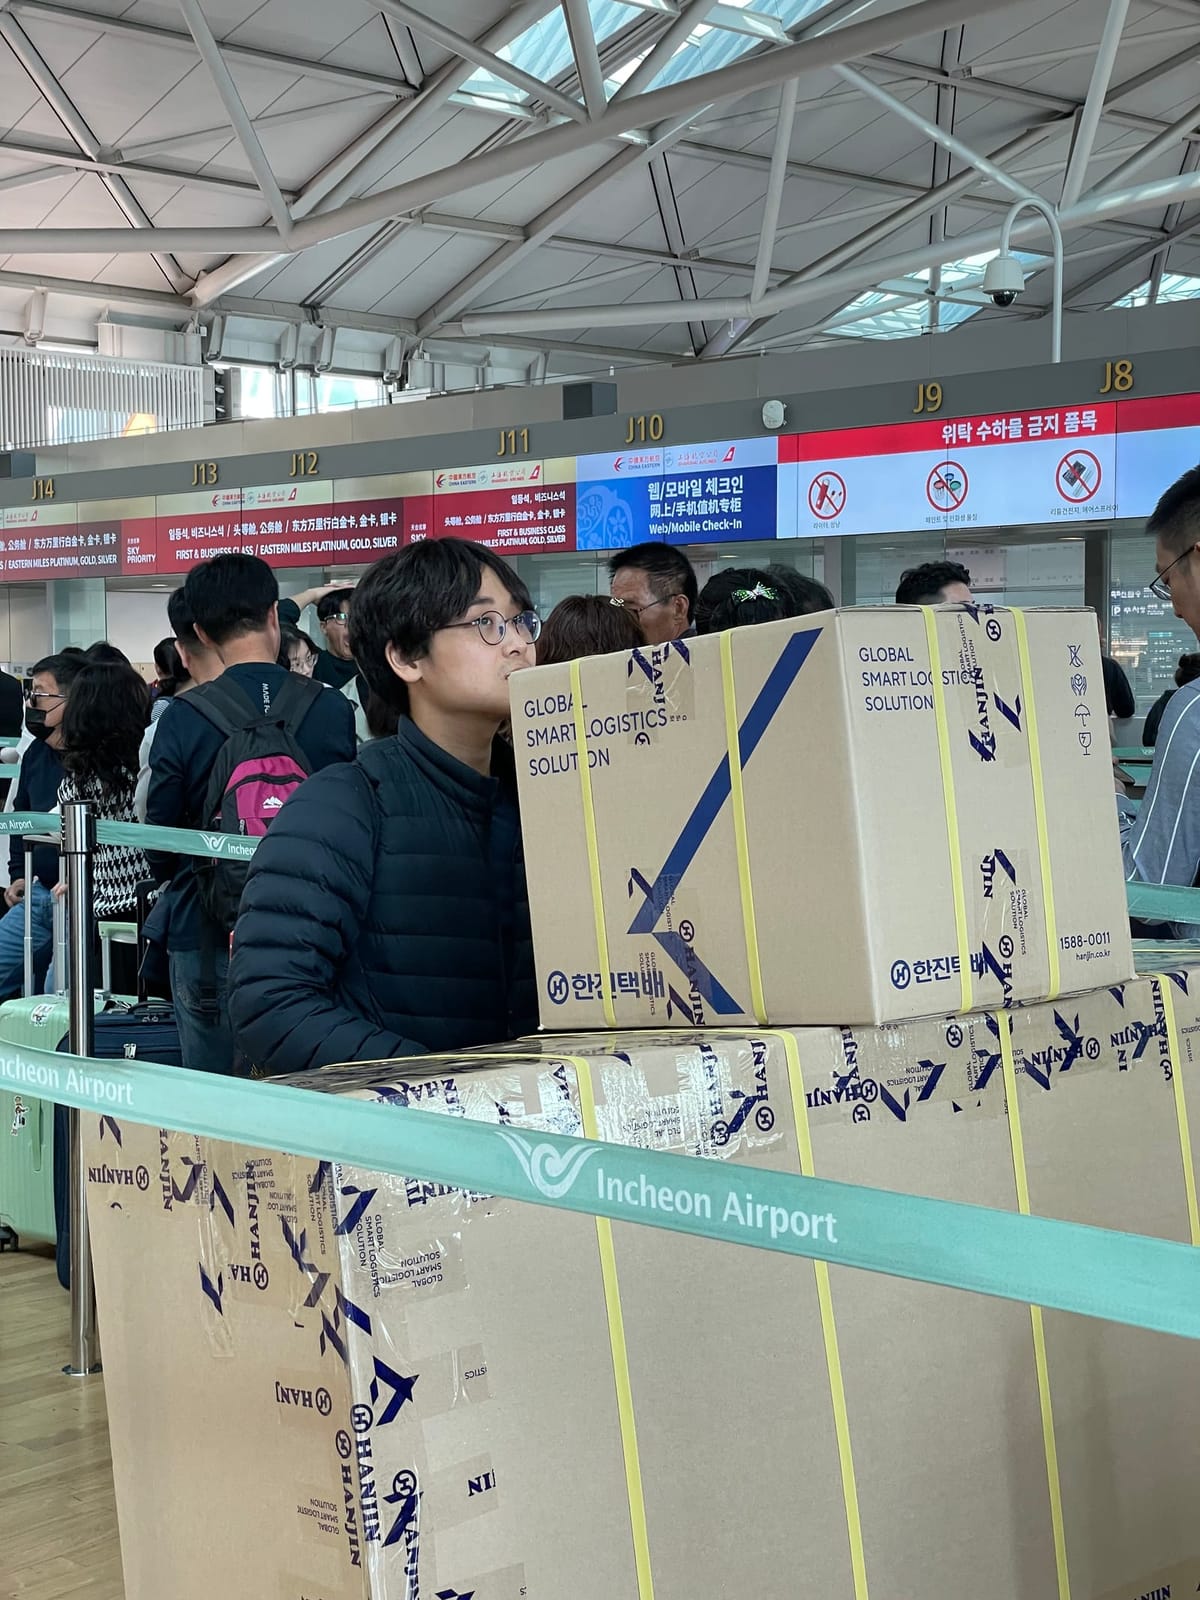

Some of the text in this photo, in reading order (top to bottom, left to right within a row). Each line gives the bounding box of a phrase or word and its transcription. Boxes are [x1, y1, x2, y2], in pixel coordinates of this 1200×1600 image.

[1099, 359, 1133, 393] J8
[913, 382, 943, 414] J9
[625, 414, 664, 443] J10
[941, 409, 1098, 445] 위탁 수하물 금지 품목
[497, 428, 529, 456] J11
[192, 463, 218, 485] J13
[289, 452, 318, 476] J12
[32, 478, 55, 500] J14
[648, 474, 744, 501] 웹/모바일 체크인
[650, 497, 742, 519] 网上/手机值机专柜
[191, 524, 224, 539] 비즈니스석
[497, 528, 513, 537] FIRST
[519, 526, 548, 536] BUSINESS
[548, 525, 566, 534] CLASS
[649, 518, 743, 535] Web/Mobile Check-In
[175, 549, 194, 560] FIRST
[194, 549, 200, 559] &
[260, 543, 290, 555] EASTERN
[291, 542, 311, 553] MILES
[373, 535, 398, 548] SILVER
[546, 534, 566, 544] SILVER
[8, 558, 33, 570] EASTERN
[33, 557, 49, 569] MILES
[97, 554, 117, 566] SILVER
[127, 547, 140, 555] SKY
[127, 554, 156, 564] PRIORITY
[859, 647, 914, 662] GLOBAL
[862, 671, 907, 687] SMART
[262, 682, 271, 704] MADE
[865, 695, 934, 712] SOLUTION
[524, 692, 588, 718] GLOBA
[527, 708, 668, 748] SMART OGISTICS
[529, 748, 611, 777] SOLUTON
[9, 820, 34, 831] Airport
[1059, 931, 1112, 951] 1588-0011
[1075, 950, 1111, 962] hanjin.co.kr
[684, 945, 706, 1026] HANJIN
[0, 1053, 134, 1105] ncheon Airport
[88, 1164, 134, 1185] HANJIN
[246, 1165, 260, 1260] HANJIN
[597, 1168, 839, 1243] Incheon Airport
[365, 1216, 375, 1248] SMART
[375, 1214, 385, 1252] GLOBAL
[401, 1250, 441, 1267] SOLUTION
[415, 1262, 442, 1277] SMART
[412, 1273, 443, 1288] GLOBAL
[355, 1438, 381, 1542] HANJIN
[310, 1498, 338, 1512] SOLUTION
[320, 1512, 339, 1524] SMART
[341, 1464, 362, 1569] HANJIN
[318, 1522, 340, 1535] GLOBAL
